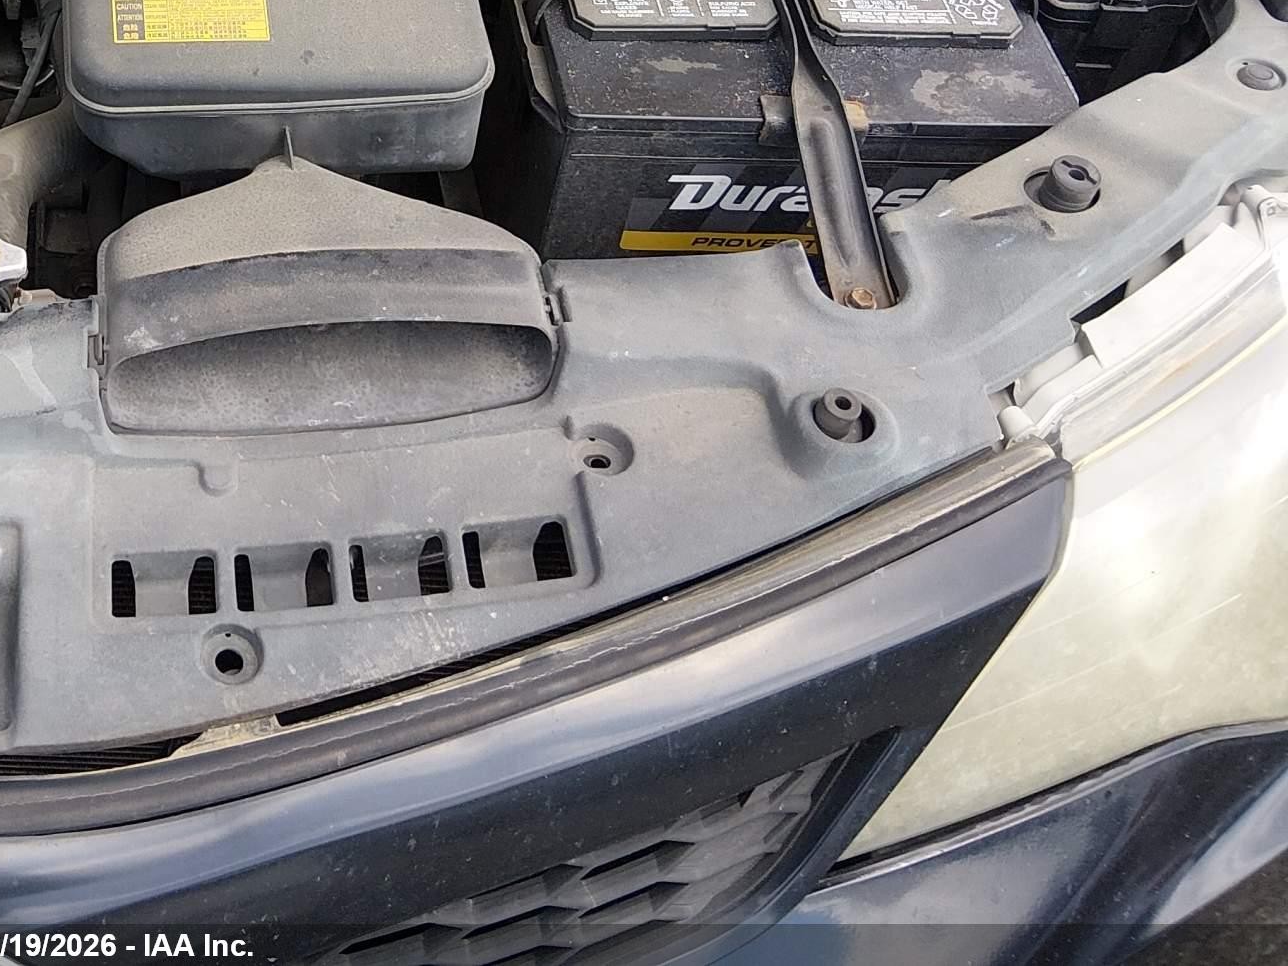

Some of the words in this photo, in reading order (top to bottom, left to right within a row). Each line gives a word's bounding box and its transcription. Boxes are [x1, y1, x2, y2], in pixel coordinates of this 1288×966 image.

[116, 2, 143, 11] CAUTION
[667, 174, 953, 214] Duras
[691, 237, 782, 250] PROVE
